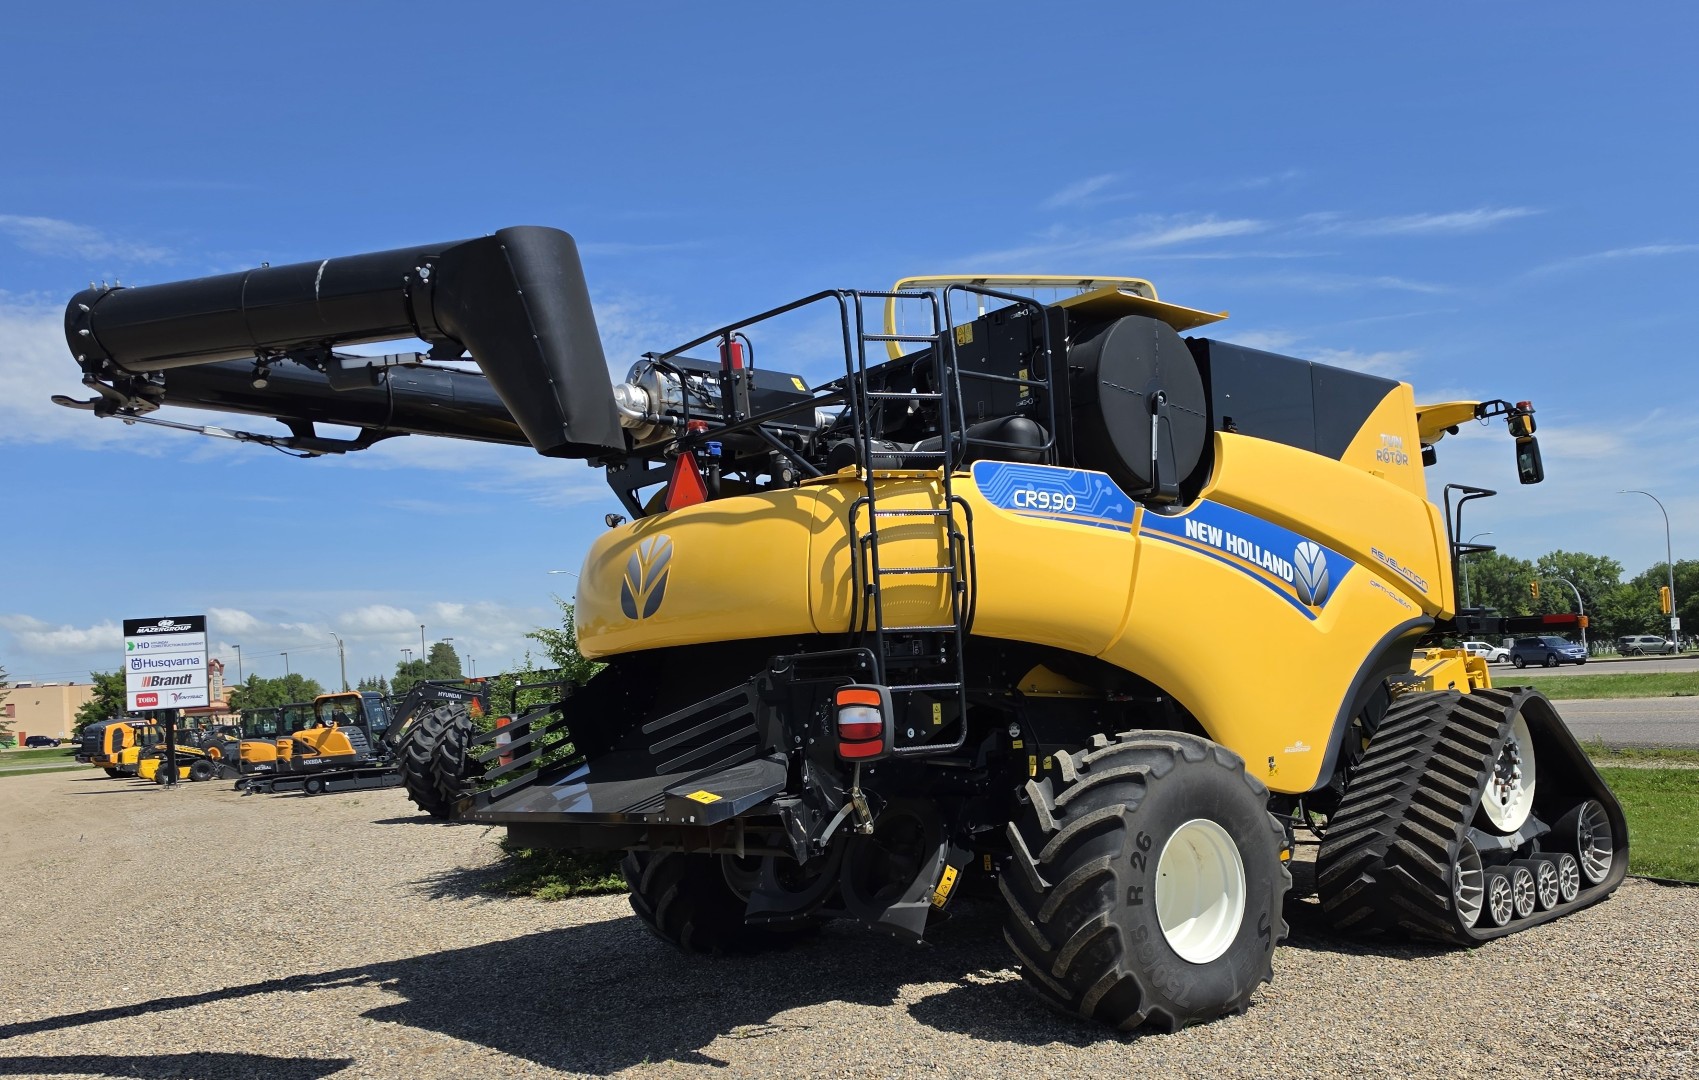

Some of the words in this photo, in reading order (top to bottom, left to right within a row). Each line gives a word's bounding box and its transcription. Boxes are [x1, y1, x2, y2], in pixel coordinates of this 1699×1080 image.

[1380, 433, 1403, 449] TWIN
[1376, 448, 1408, 466] ROTOR
[1014, 489, 1076, 512] CR9.90
[1185, 518, 1222, 547] NEW
[1226, 532, 1294, 582] HOLLAND
[1371, 547, 1429, 590] REVELATION
[1370, 580, 1412, 611] OPTI-CLEAN
[136, 625, 191, 633] MAZERGROUP
[143, 657, 200, 668] Husqvarna
[151, 674, 192, 687] Brandt
[438, 691, 462, 699] HYUNDAI
[1130, 830, 1153, 873] 26
[1126, 884, 1144, 907] R
